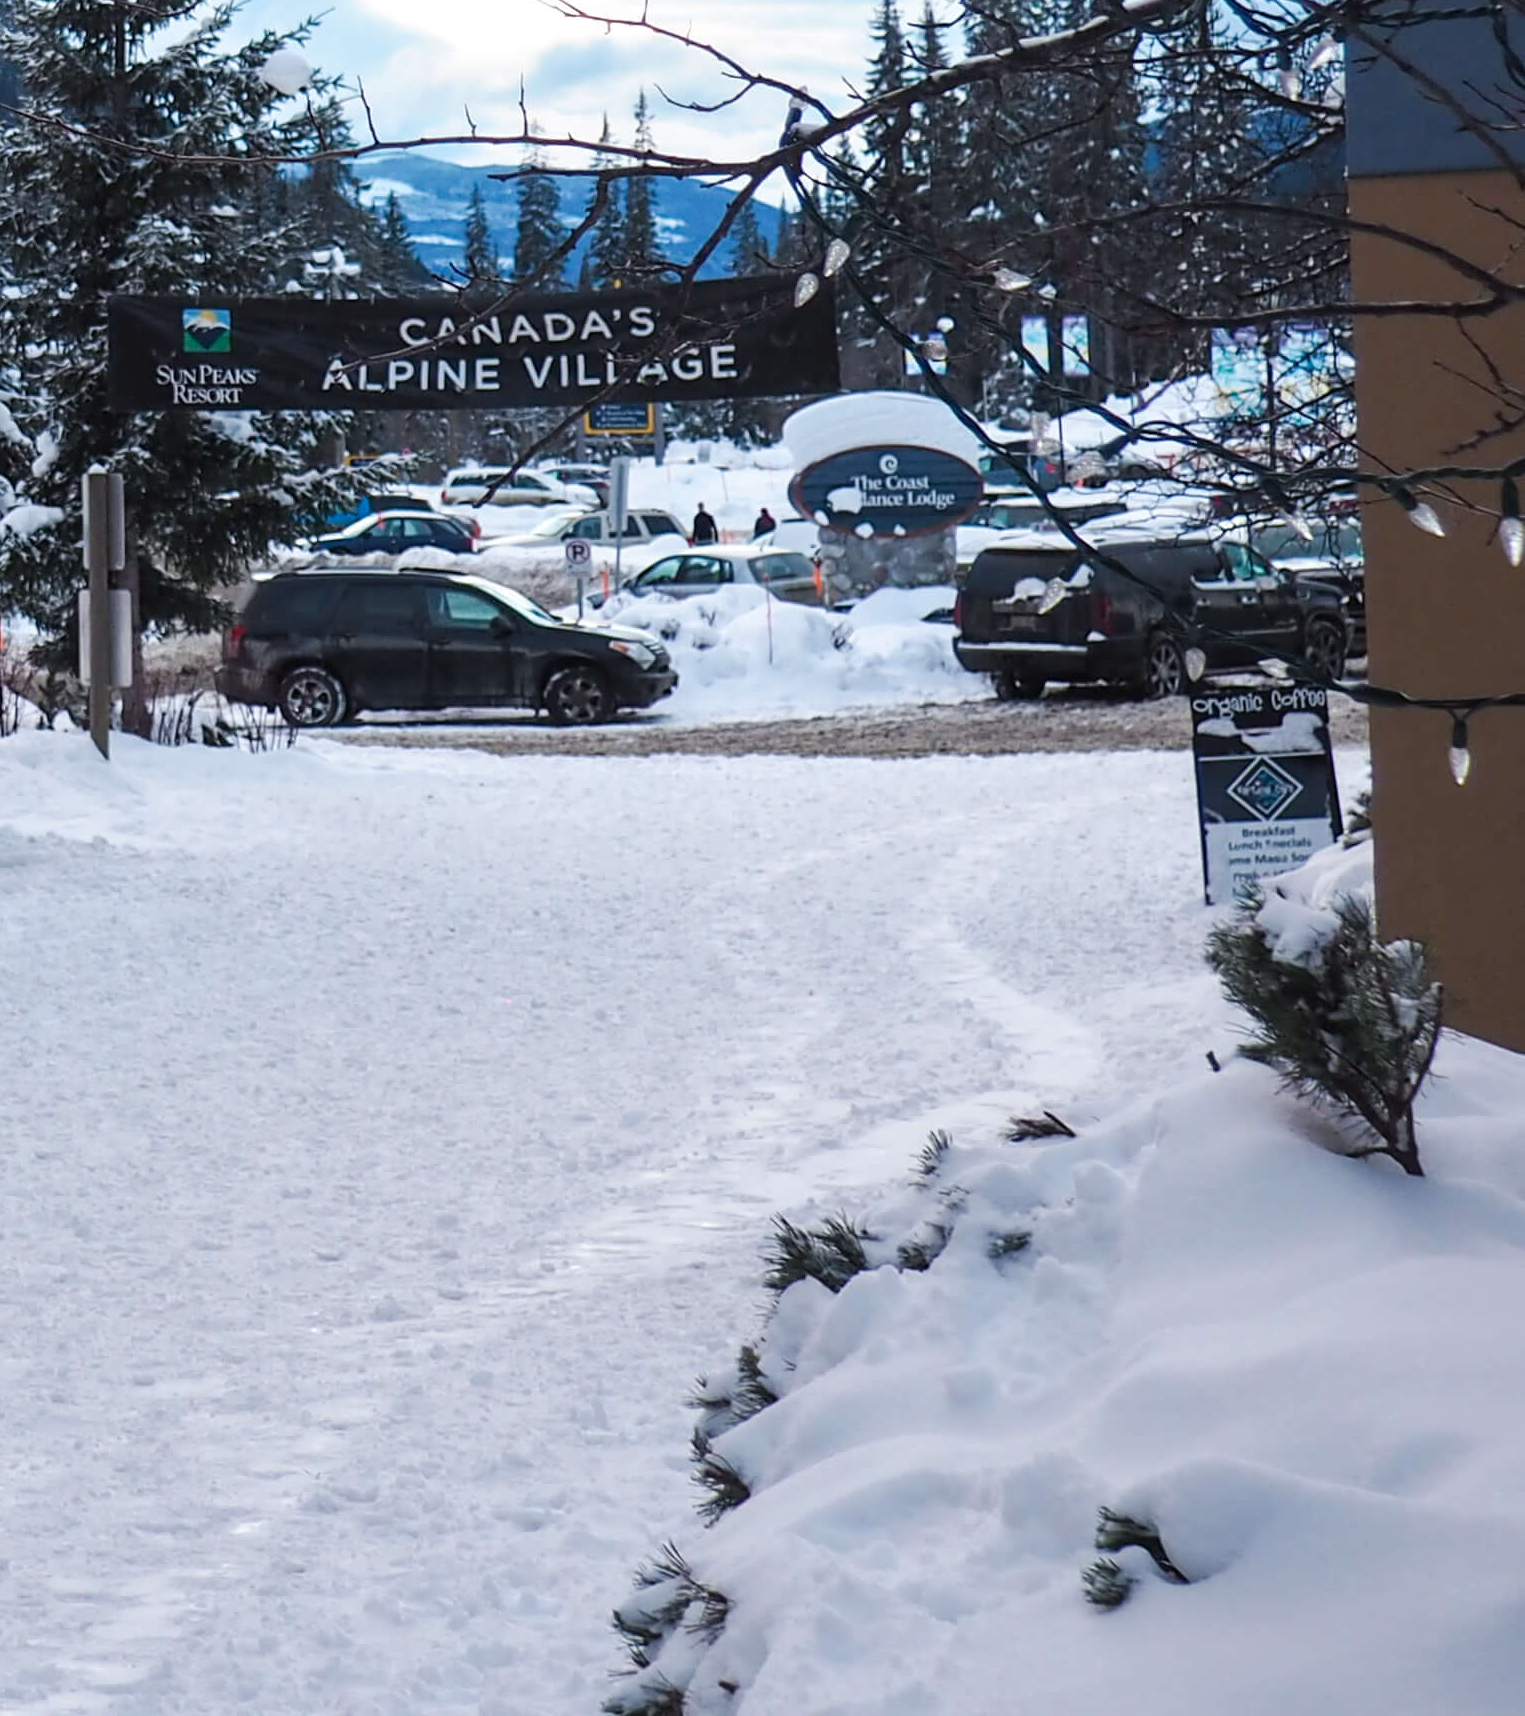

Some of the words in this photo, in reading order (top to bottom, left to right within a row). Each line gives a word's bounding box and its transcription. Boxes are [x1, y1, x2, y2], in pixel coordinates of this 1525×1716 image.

[399, 307, 656, 346] CANADA'S
[322, 357, 501, 392] ALPINE
[850, 475, 883, 491] The
[885, 475, 930, 491] Coast
[907, 489, 956, 510] Lodge
[1192, 692, 1263, 719] organic
[1241, 825, 1296, 838] Breakfast
[1228, 841, 1262, 852] Lunch
